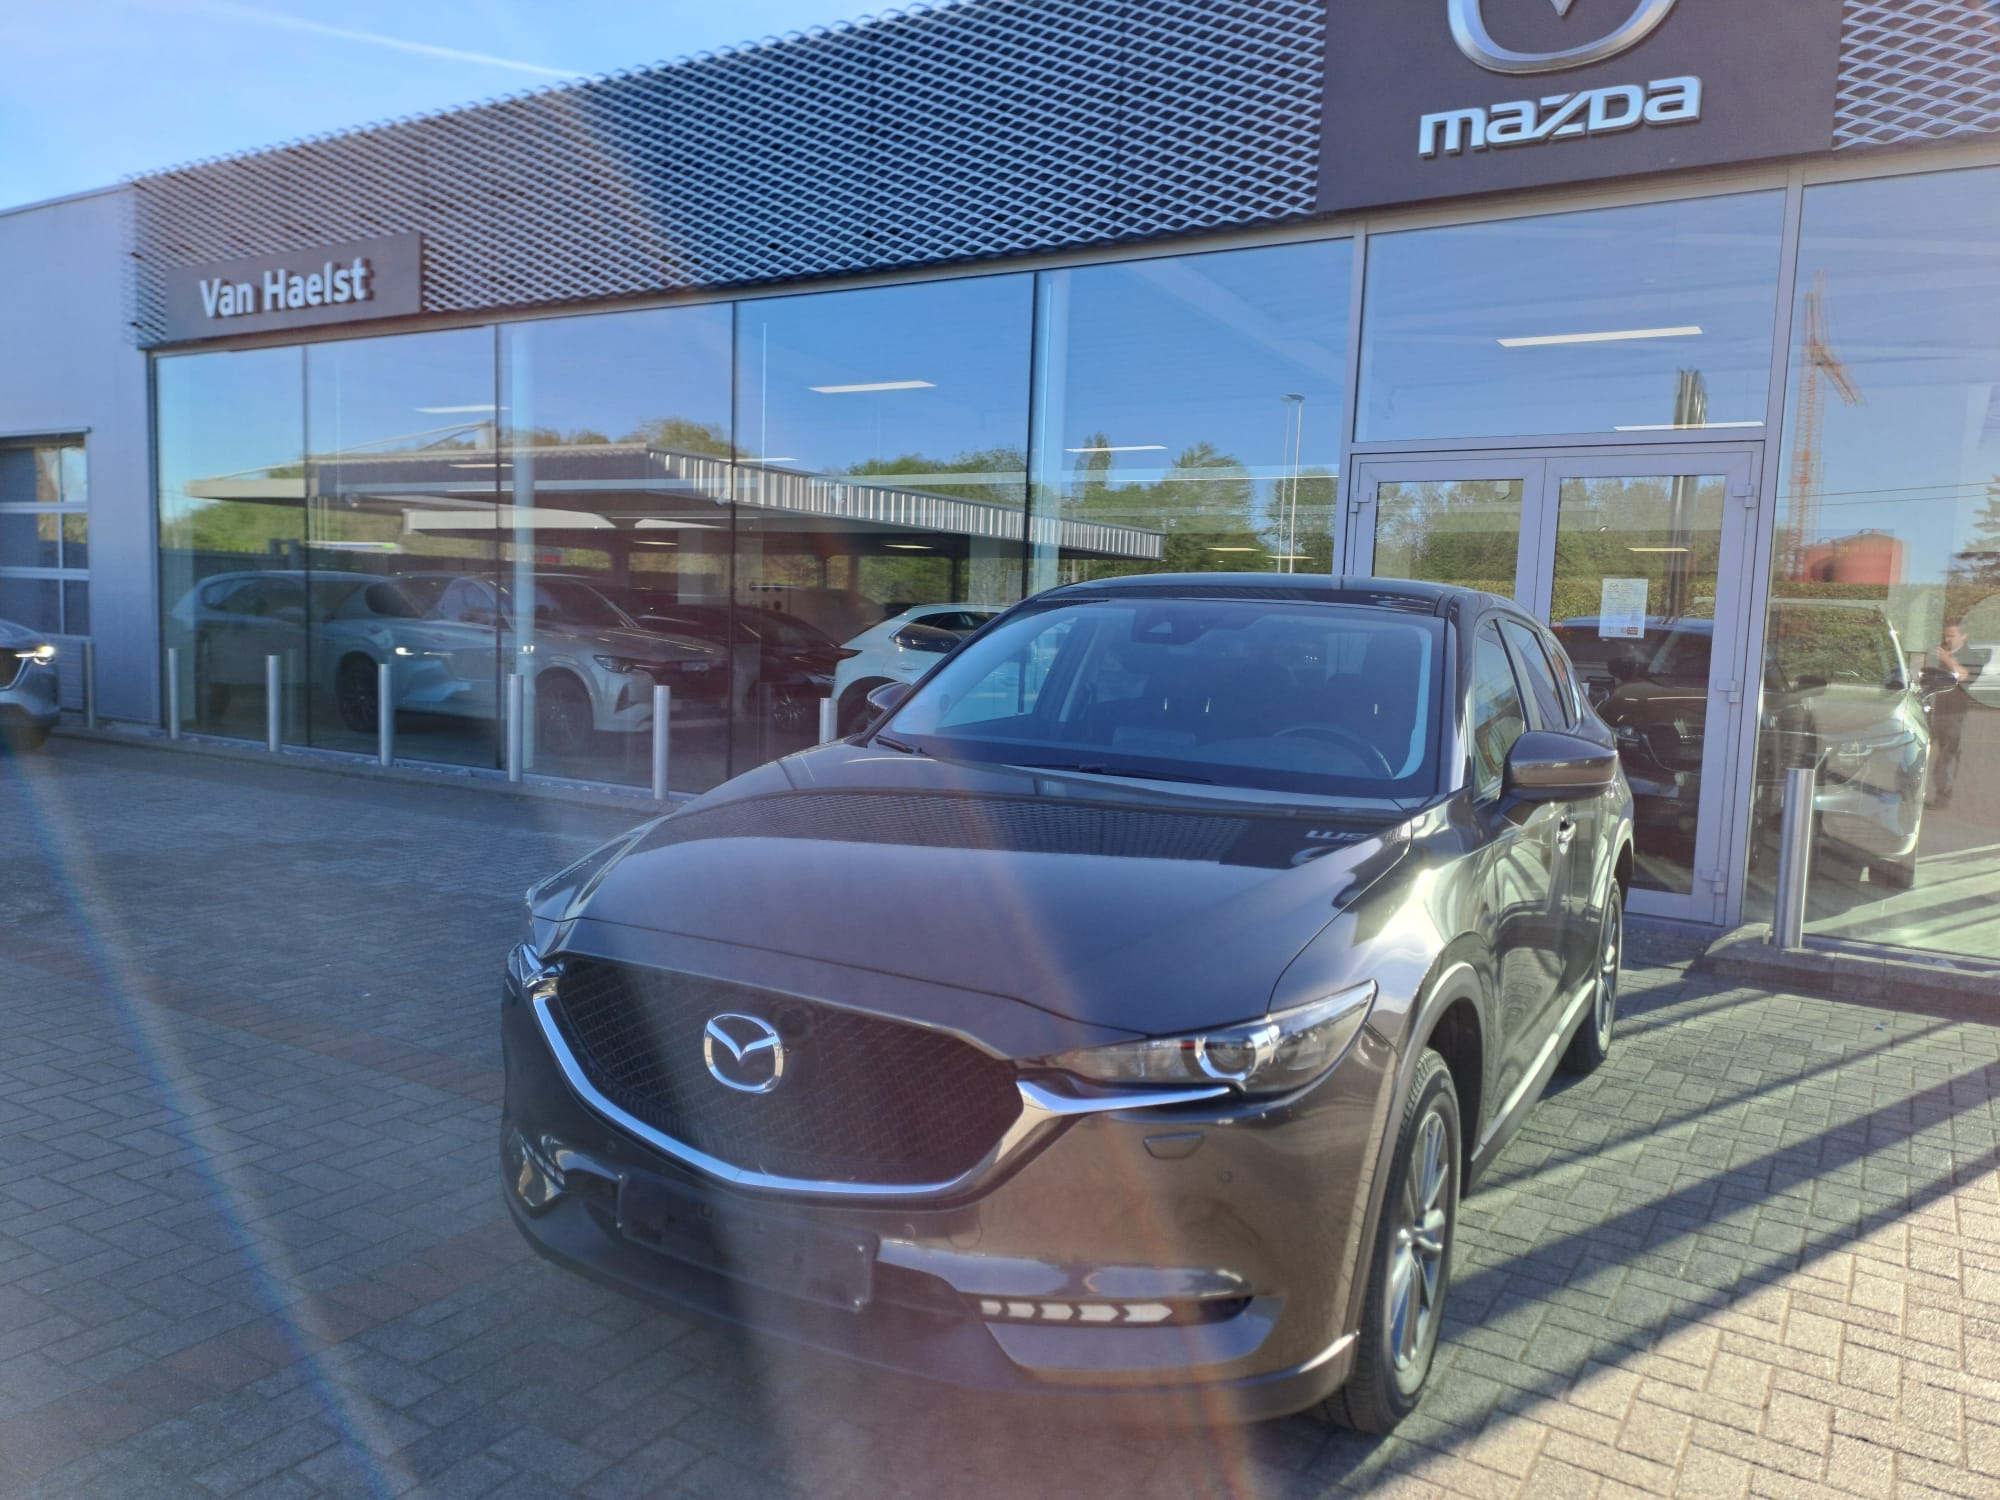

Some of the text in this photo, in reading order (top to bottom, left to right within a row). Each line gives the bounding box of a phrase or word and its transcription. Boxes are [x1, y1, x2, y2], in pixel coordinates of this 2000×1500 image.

[1418, 75, 1701, 157] mazda
[200, 257, 368, 318] Van Haelst
